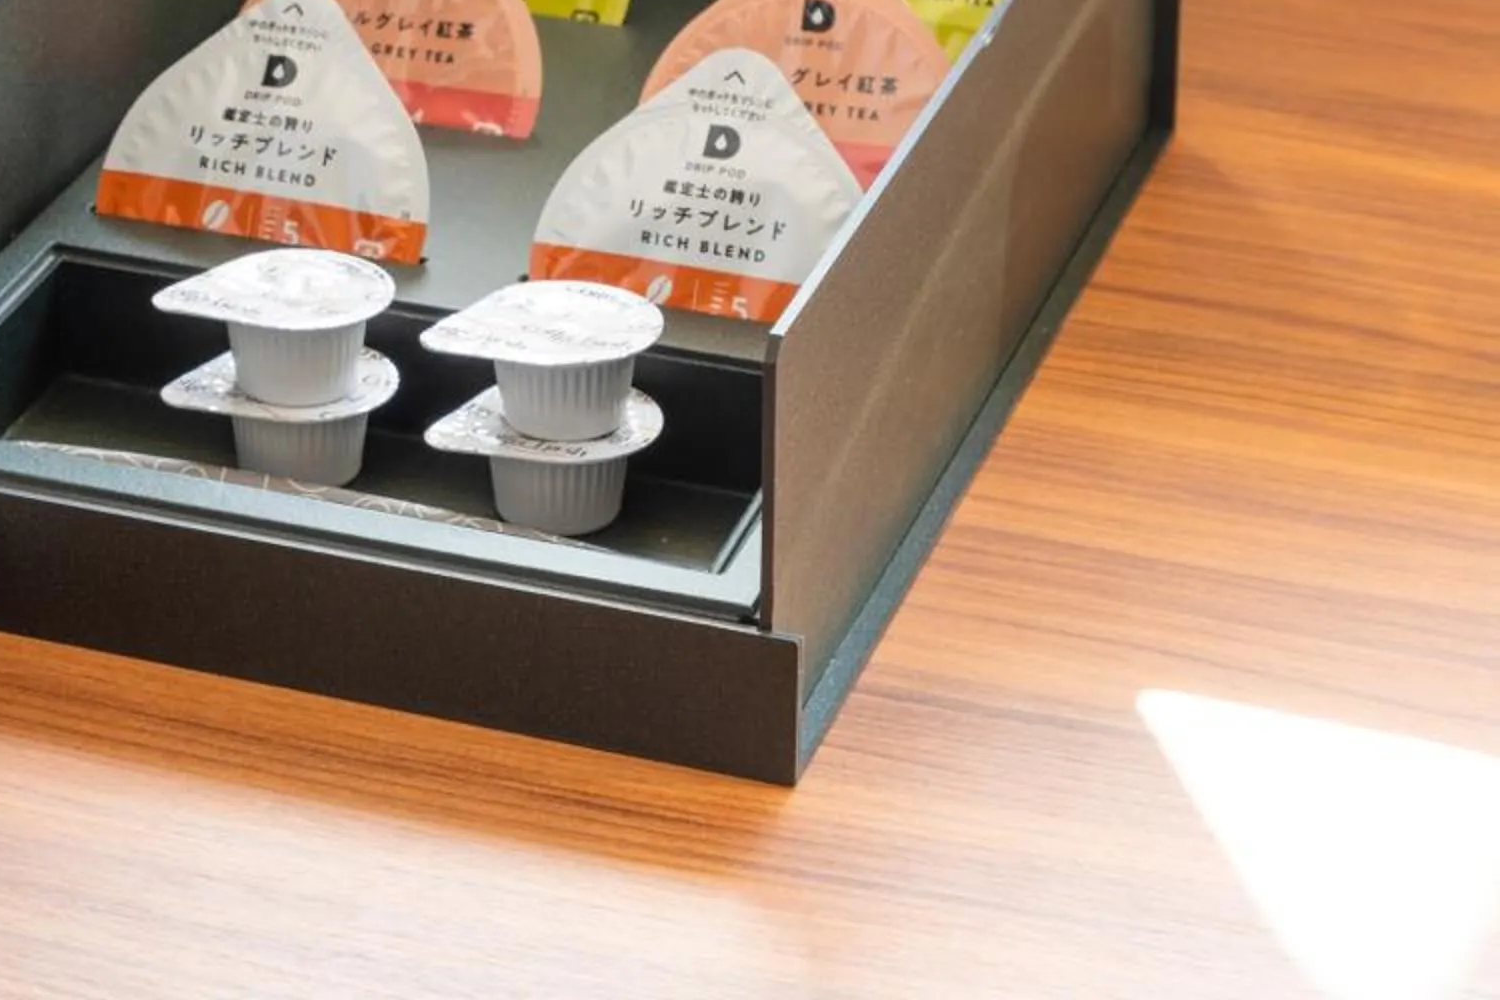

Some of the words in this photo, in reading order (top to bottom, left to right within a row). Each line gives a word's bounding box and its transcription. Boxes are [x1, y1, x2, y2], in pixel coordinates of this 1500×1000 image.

[261, 53, 298, 88] D
[426, 50, 455, 64] TEA
[848, 105, 879, 121] TEA
[190, 125, 338, 167] リッチブレンド
[702, 123, 741, 160] D
[199, 155, 246, 176] RICH
[255, 165, 316, 188] BLEND
[684, 161, 715, 174] DRIP
[718, 166, 746, 180] POD
[630, 199, 787, 241] リッチブレンド
[641, 230, 690, 251] RICH
[700, 240, 766, 263] BLEND
